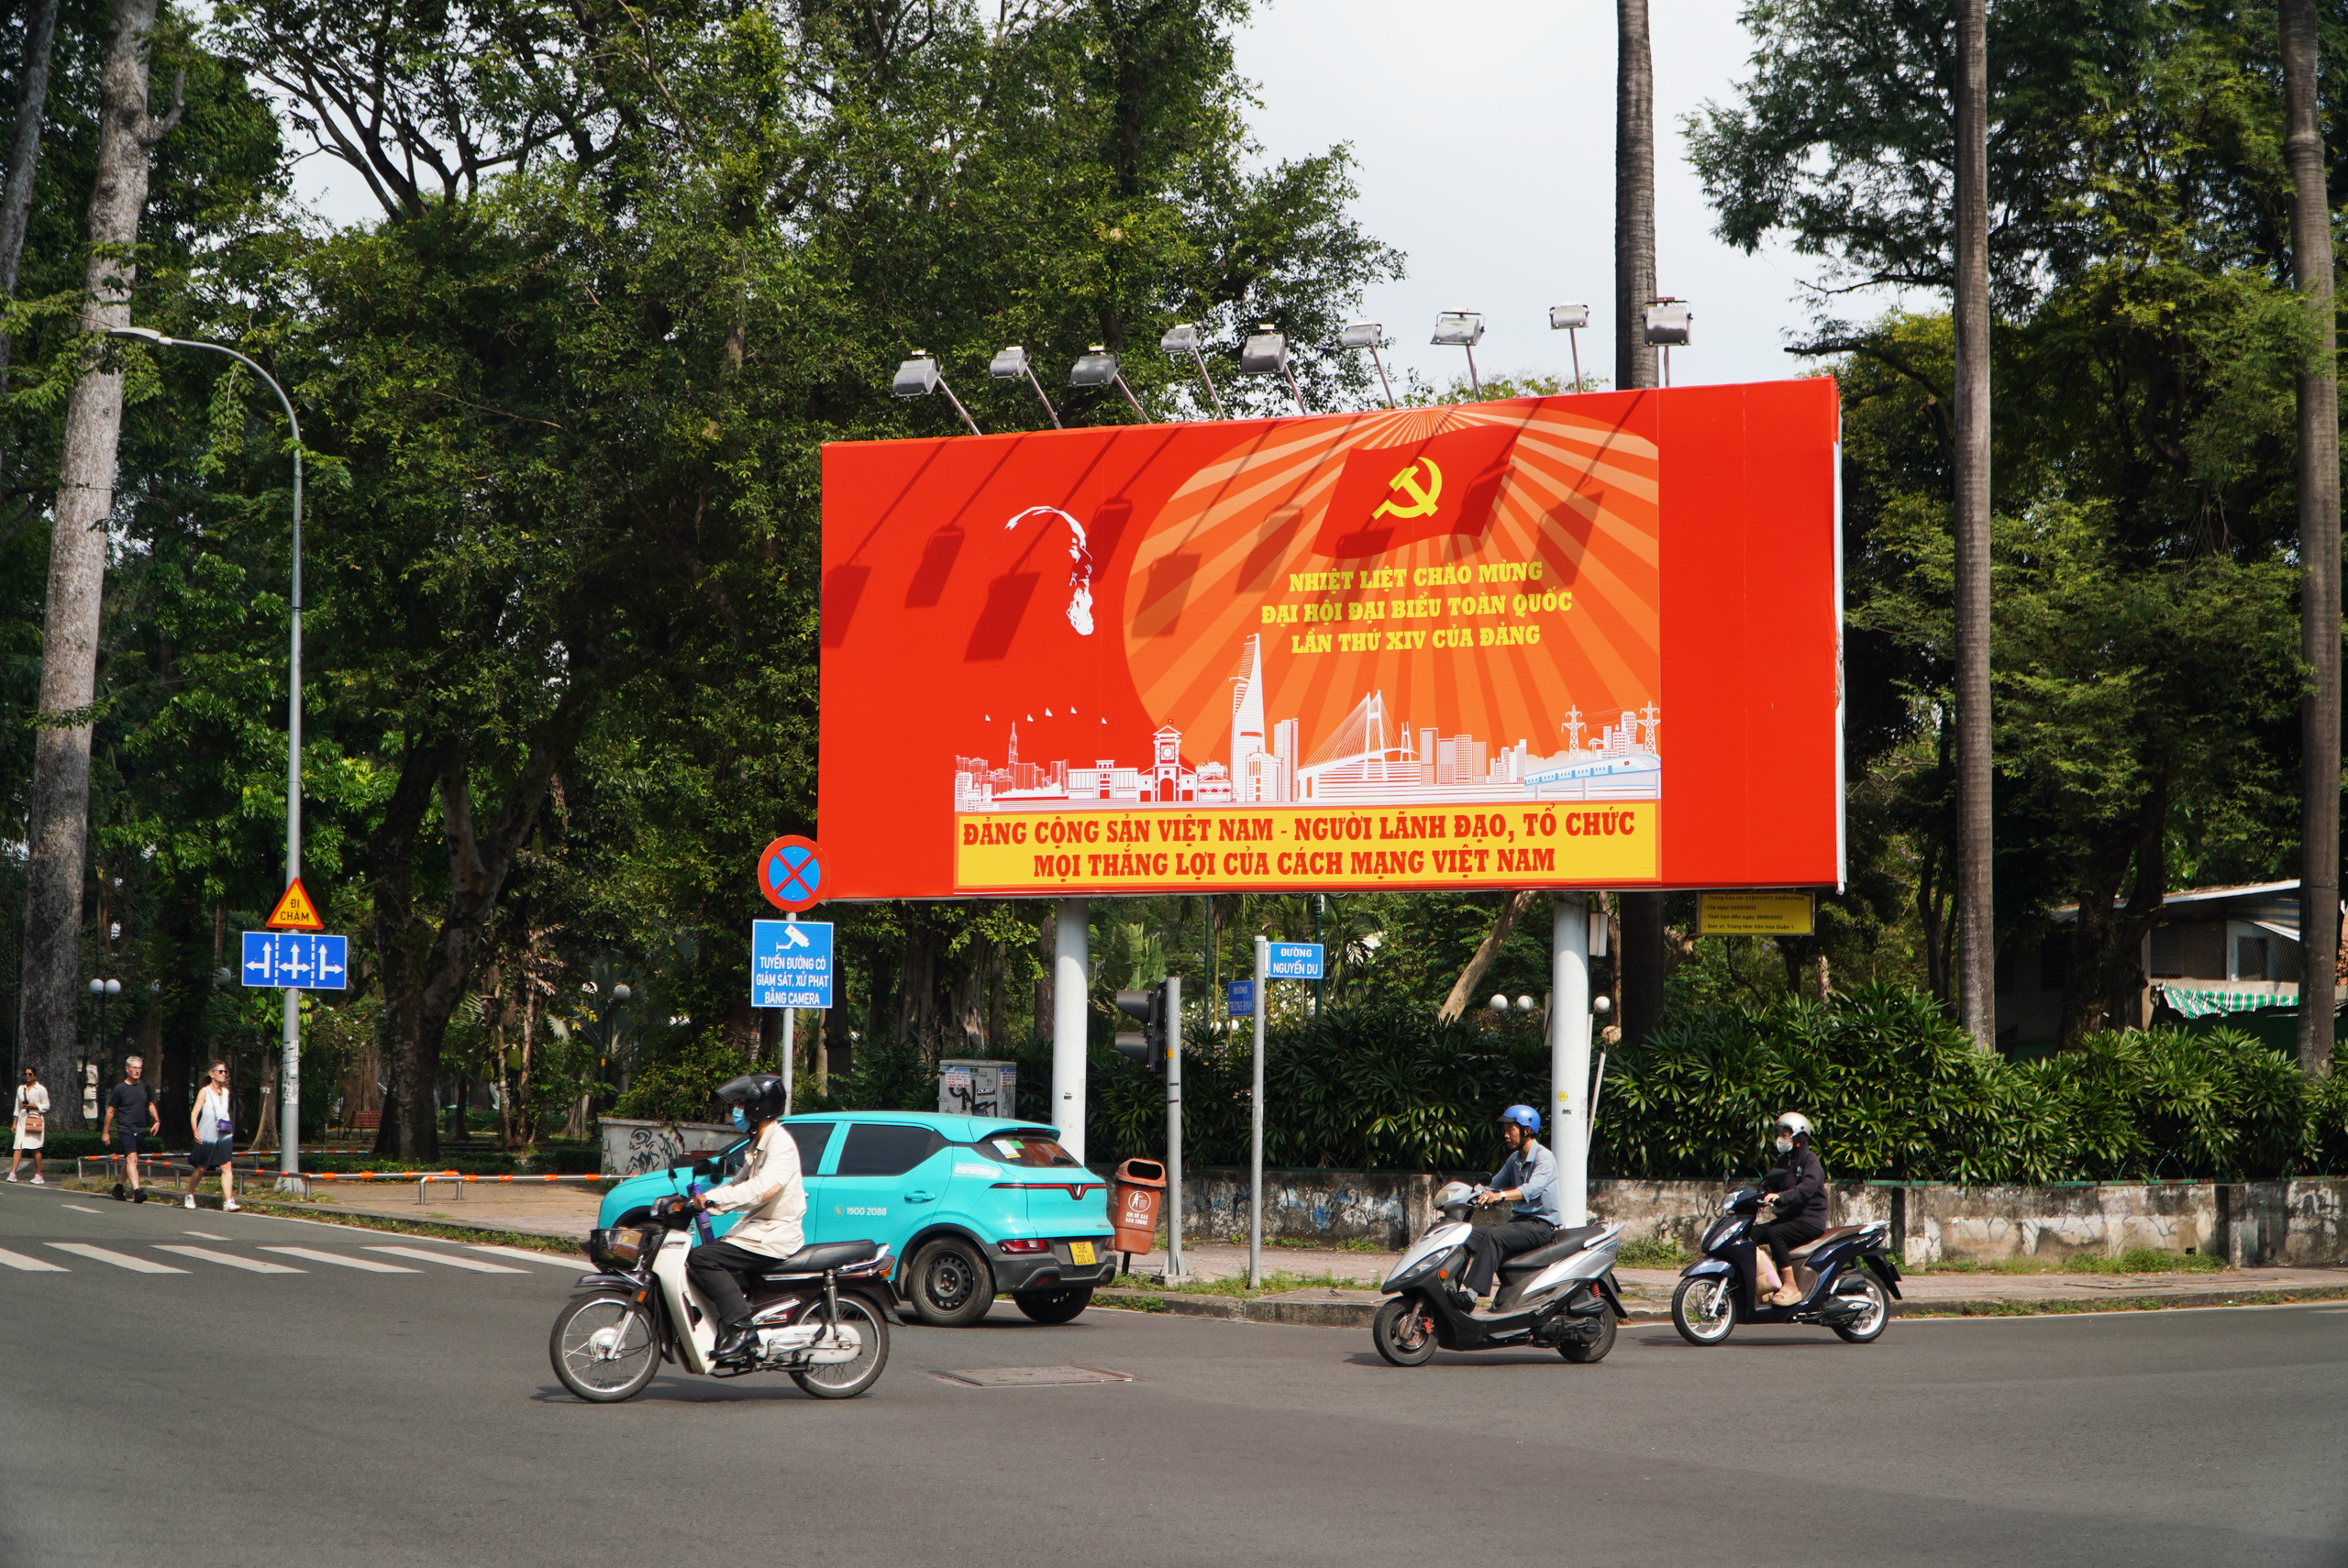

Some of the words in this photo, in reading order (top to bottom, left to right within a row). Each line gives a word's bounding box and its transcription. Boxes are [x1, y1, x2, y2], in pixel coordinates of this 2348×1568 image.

[1290, 568, 1355, 594] NHIỆT
[1359, 566, 1406, 592] LIỆT
[1413, 562, 1472, 588] CHÀO
[1479, 559, 1543, 583] MỪNG
[1261, 605, 1299, 627] ĐẠI
[1303, 599, 1343, 625] HỘI
[1348, 601, 1386, 624] ĐẠI
[1391, 591, 1442, 620] BIỂU
[1447, 591, 1507, 616] TOÀN
[1512, 586, 1573, 618] QUỐC
[1291, 627, 1333, 654] LẦN
[1338, 628, 1381, 652] THỨ
[1386, 630, 1426, 650] XIV
[1432, 624, 1474, 648] CỦA
[1479, 622, 1541, 646] ĐẢNG
[963, 816, 1026, 845] ĐẢNG
[1034, 815, 1100, 850] CỘNG
[1106, 813, 1151, 843] SẢN
[1157, 813, 1212, 847] VIỆT
[1218, 817, 1273, 842] NAM
[1294, 812, 1372, 841] NGƯỜI
[1379, 811, 1446, 839] LÃNH
[1454, 813, 1515, 844] ĐẠO,
[1523, 802, 1557, 837] TỔ
[1565, 806, 1635, 836] CHỨC
[1034, 854, 1081, 883] MỌI
[1088, 843, 1168, 877] THẮNG
[1175, 851, 1216, 880] LỢI
[1223, 845, 1270, 876] CỦA
[1277, 846, 1343, 876] CÁCH
[1350, 850, 1424, 880] MẠNG
[1432, 844, 1490, 878] VIỆT
[1497, 848, 1556, 873] NAM
[290, 899, 300, 909] ĐI
[280, 910, 309, 924] CHẬM
[1280, 946, 1312, 957] ĐƯỜNG
[759, 953, 786, 969] TUYẾN
[787, 955, 814, 970] ĐƯỜNG
[815, 955, 826, 971] CÓ
[1307, 964, 1319, 975] DU
[756, 971, 777, 986] GIÁM
[795, 971, 808, 987] XỬ
[808, 975, 829, 990] PHẠT
[764, 987, 787, 1004] BẰNG
[788, 992, 820, 1005] CAMERA
[847, 1207, 865, 1215] 1900
[867, 1207, 887, 1216] 2088
